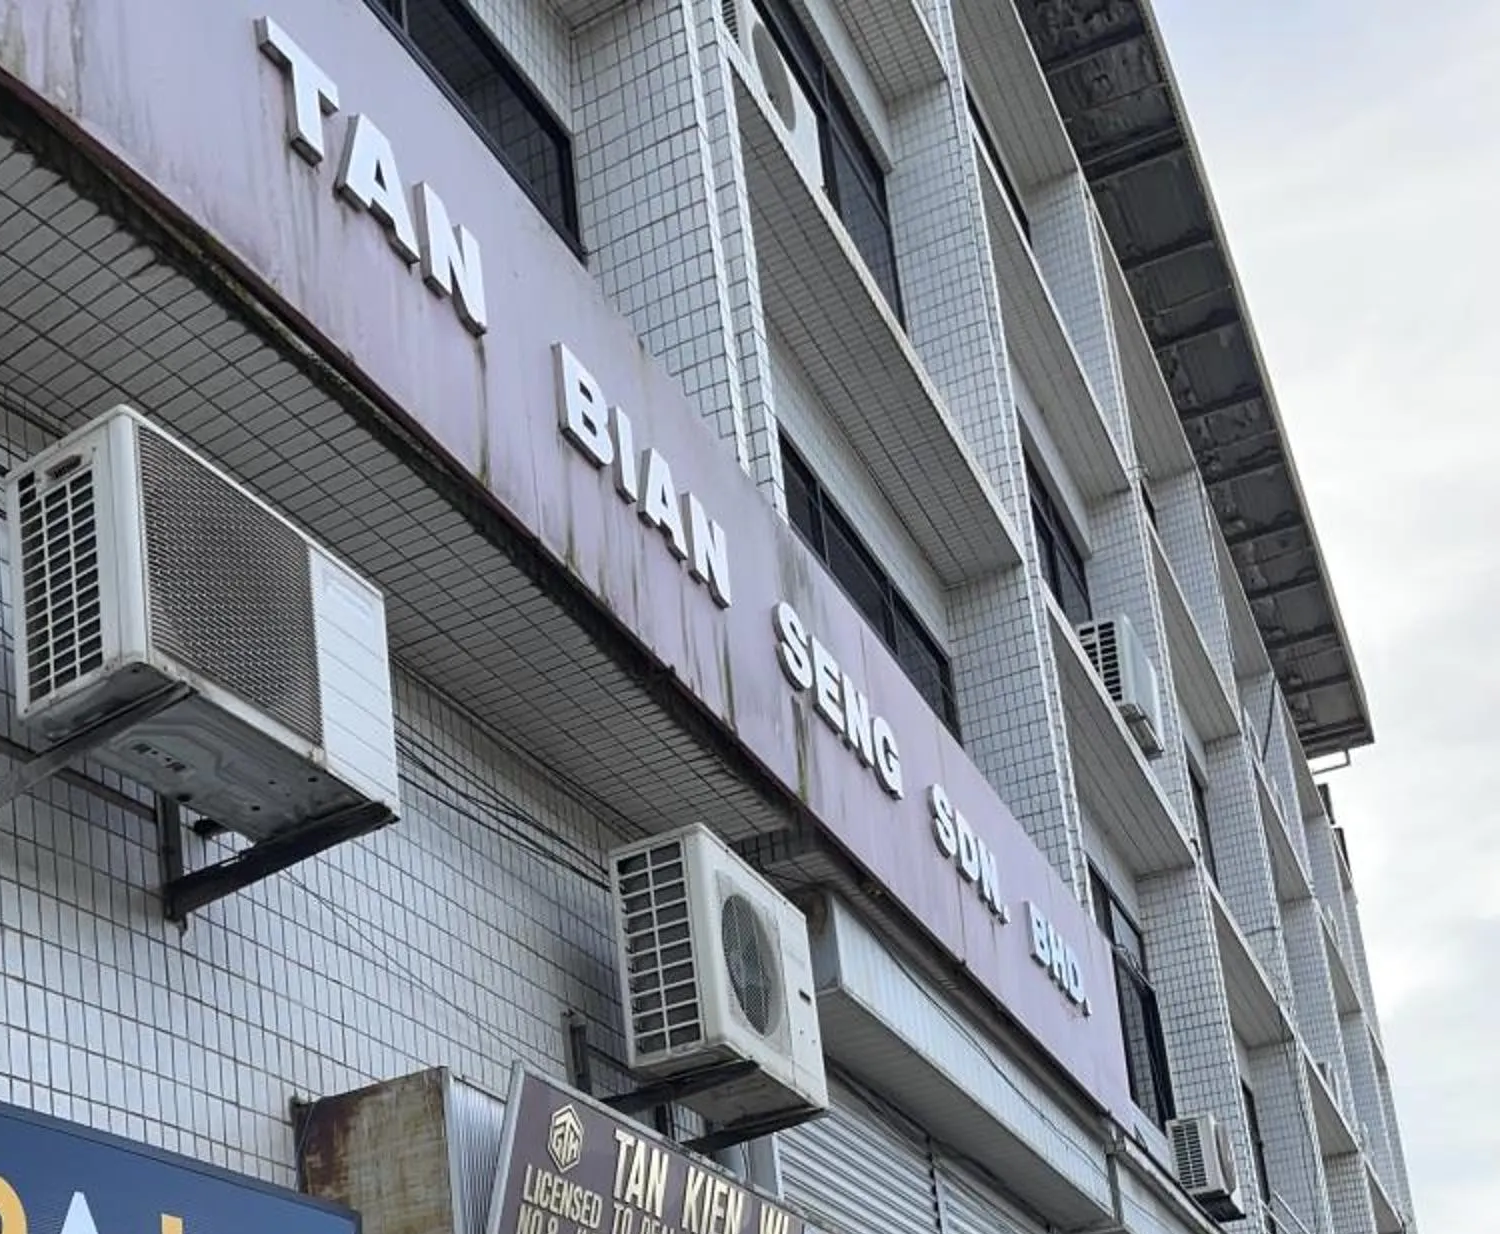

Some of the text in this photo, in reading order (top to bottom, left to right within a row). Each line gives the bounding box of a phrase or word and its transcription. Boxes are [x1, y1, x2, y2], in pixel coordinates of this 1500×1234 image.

[256, 15, 486, 336] TAN
[554, 342, 731, 608] BIAN
[773, 602, 904, 800] SENG
[928, 784, 1010, 924] SDN.
[523, 1164, 602, 1229] LICENSED
[612, 1129, 668, 1217] TAN
